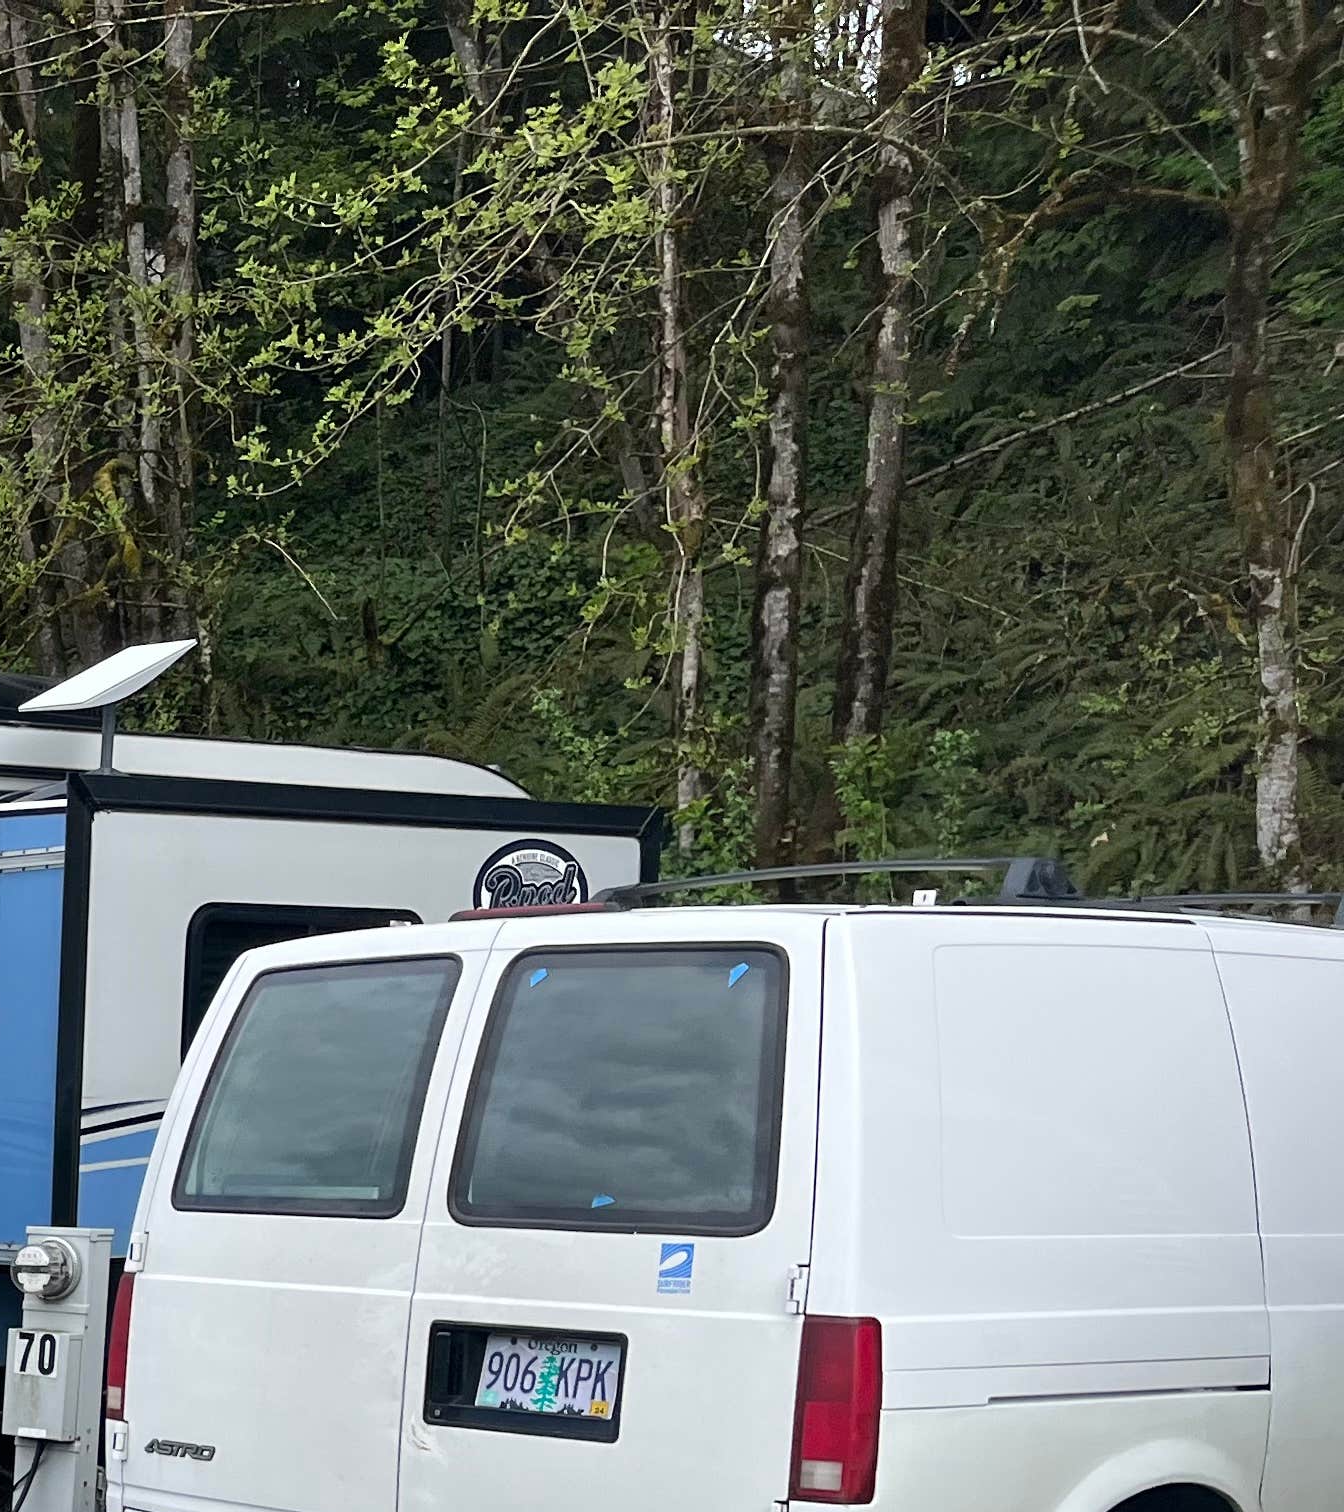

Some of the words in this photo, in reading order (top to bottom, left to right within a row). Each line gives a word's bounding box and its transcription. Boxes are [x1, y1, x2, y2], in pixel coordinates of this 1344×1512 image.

[18, 1331, 57, 1376] 70
[527, 1337, 578, 1356] Oregon
[486, 1351, 539, 1394] 906
[554, 1357, 615, 1402] KPK
[144, 1438, 216, 1462] ASTRO
